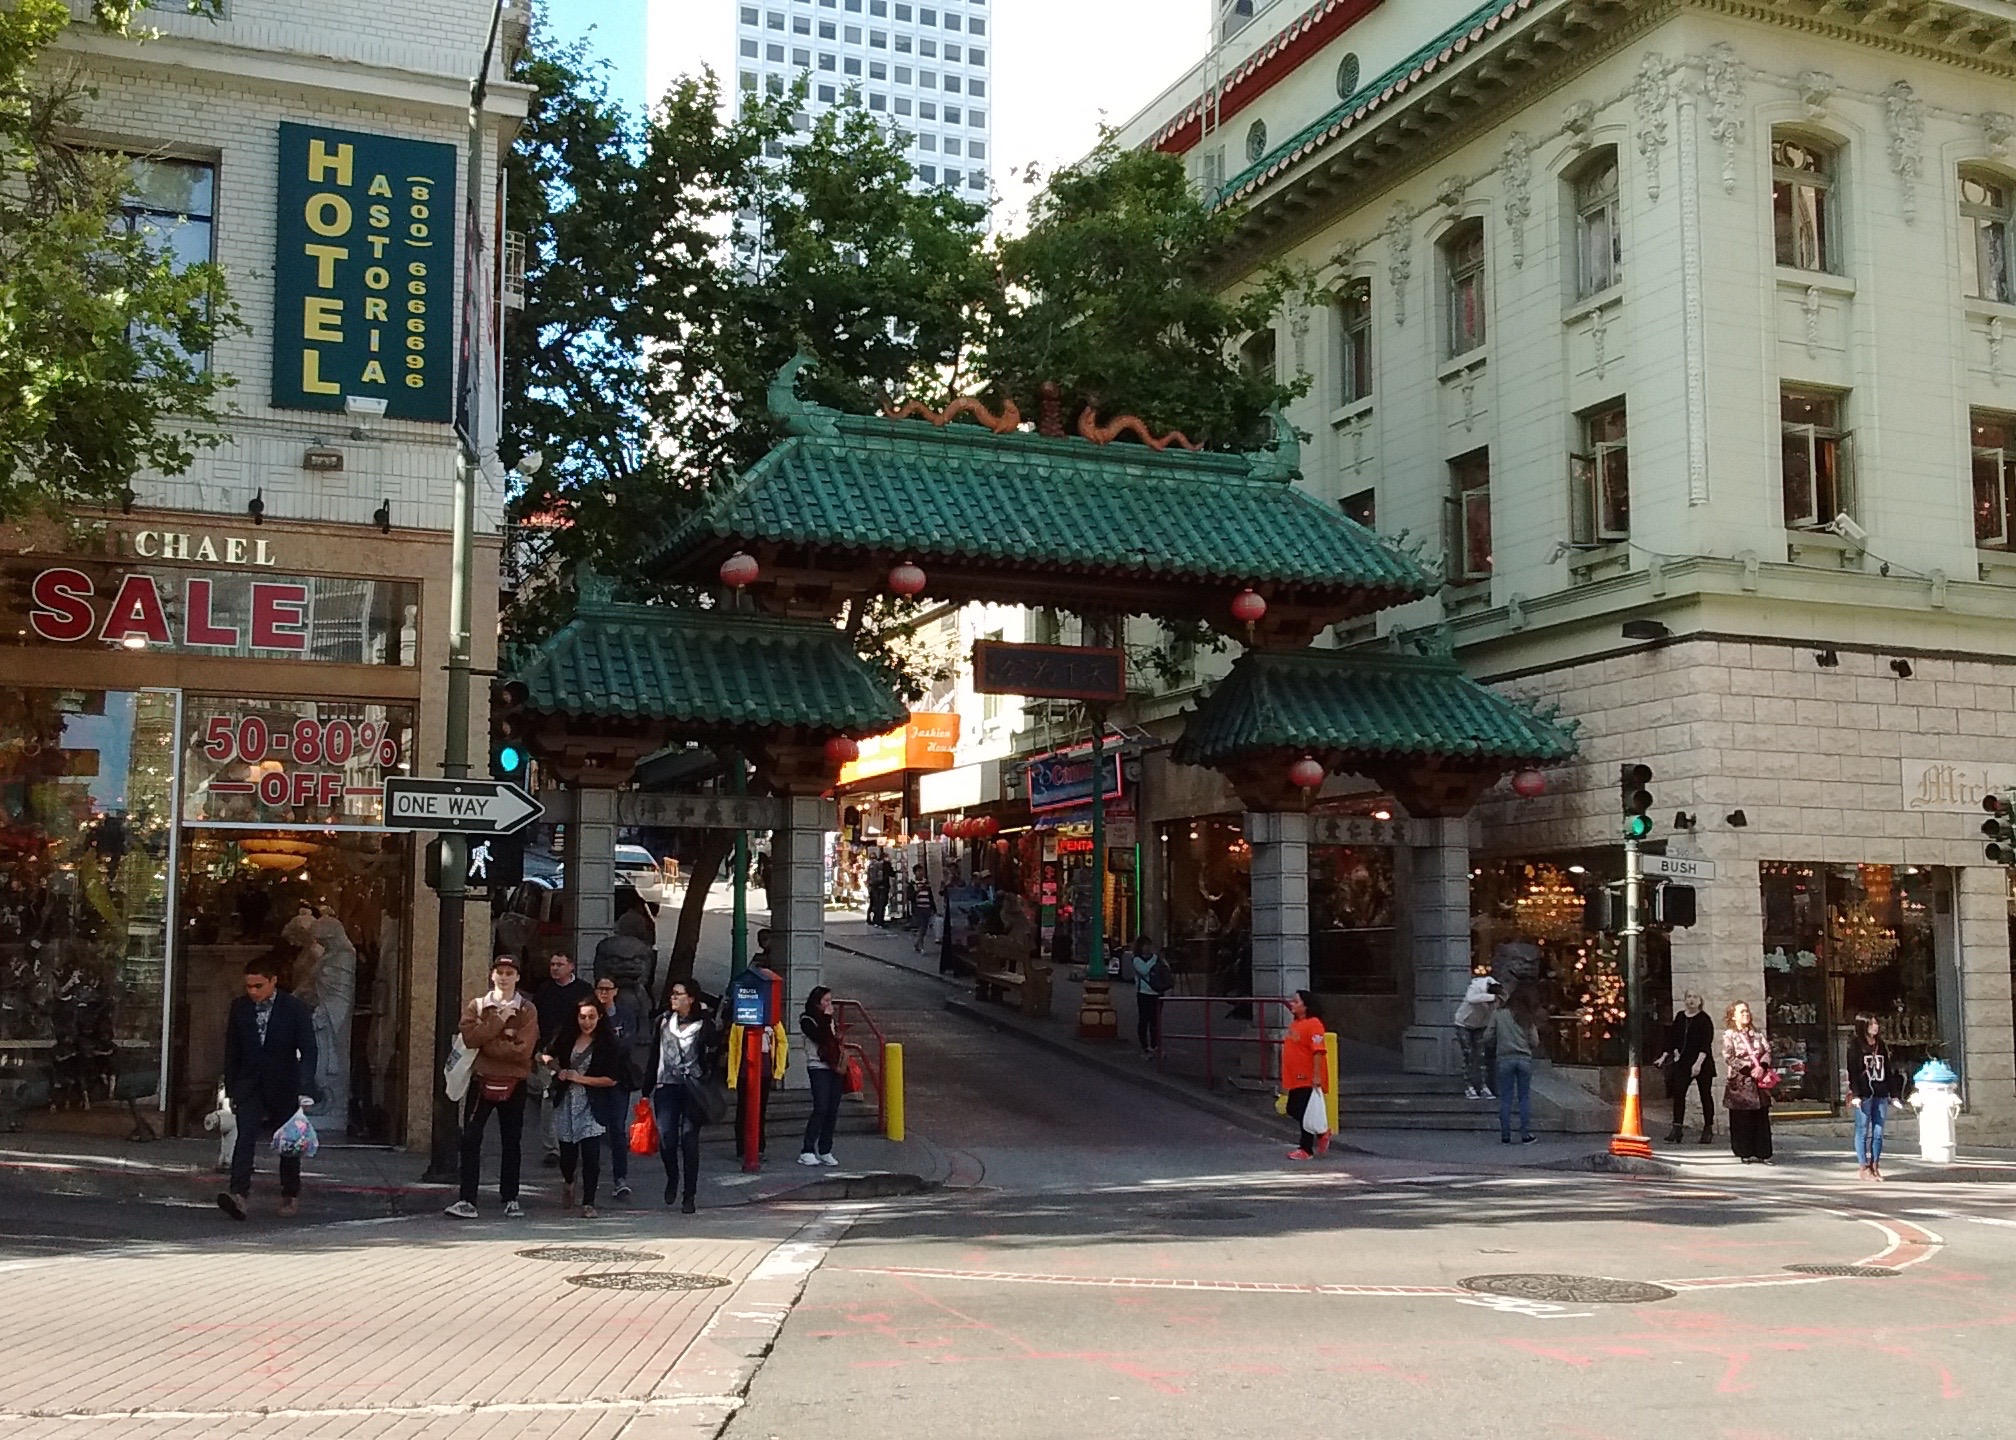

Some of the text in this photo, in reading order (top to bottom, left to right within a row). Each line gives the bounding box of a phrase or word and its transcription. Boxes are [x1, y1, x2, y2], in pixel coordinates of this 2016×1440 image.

[303, 138, 354, 395] HOTEL
[361, 174, 393, 385] ASTORIA
[404, 176, 435, 388] (800) 6666696
[29, 567, 309, 651] SALE
[204, 715, 397, 767] 50-80%
[259, 771, 343, 807] OFF
[397, 795, 490, 816] ONE WAY
[1661, 860, 1698, 875] BUSH
[1863, 1054, 1885, 1082] W
